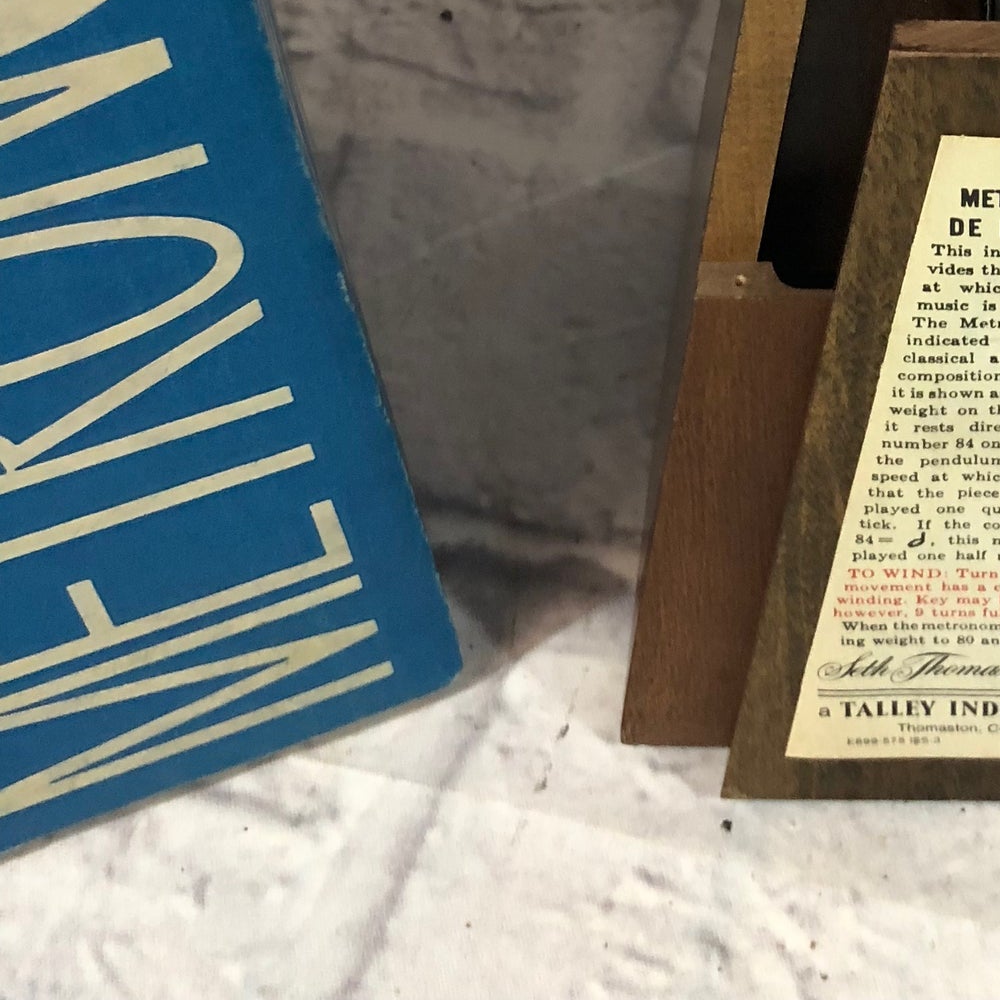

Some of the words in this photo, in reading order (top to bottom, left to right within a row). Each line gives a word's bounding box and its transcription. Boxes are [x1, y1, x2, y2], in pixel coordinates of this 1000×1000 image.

[950, 217, 982, 238] DE
[931, 244, 972, 257] This
[927, 262, 974, 276] vides
[922, 282, 941, 293] at
[917, 299, 969, 311] music
[982, 300, 996, 312] is
[912, 317, 947, 328] The
[907, 334, 990, 346] indicated
[903, 352, 974, 364] classical
[892, 387, 905, 398] it
[910, 387, 924, 399] is
[928, 388, 984, 399] shown
[889, 404, 947, 418] weight
[958, 408, 978, 416] on
[885, 420, 898, 432] it
[914, 423, 954, 433] rests
[882, 438, 948, 450] number
[956, 438, 974, 449] 84
[876, 454, 903, 465] the
[872, 472, 919, 484] speed
[931, 472, 948, 482] at
[868, 487, 904, 498] that
[917, 488, 944, 498] the
[958, 487, 999, 500] piece
[864, 503, 920, 516] played
[936, 506, 965, 514] one
[860, 519, 896, 530] tick.
[918, 520, 931, 530] If
[944, 519, 970, 529] the
[852, 550, 907, 562] played
[956, 550, 987, 560] half
[848, 569, 874, 578] TO
[956, 568, 998, 578] Turn
[817, 651, 894, 681] Seth
[819, 707, 830, 717] a
[840, 700, 935, 718] TALLEY
